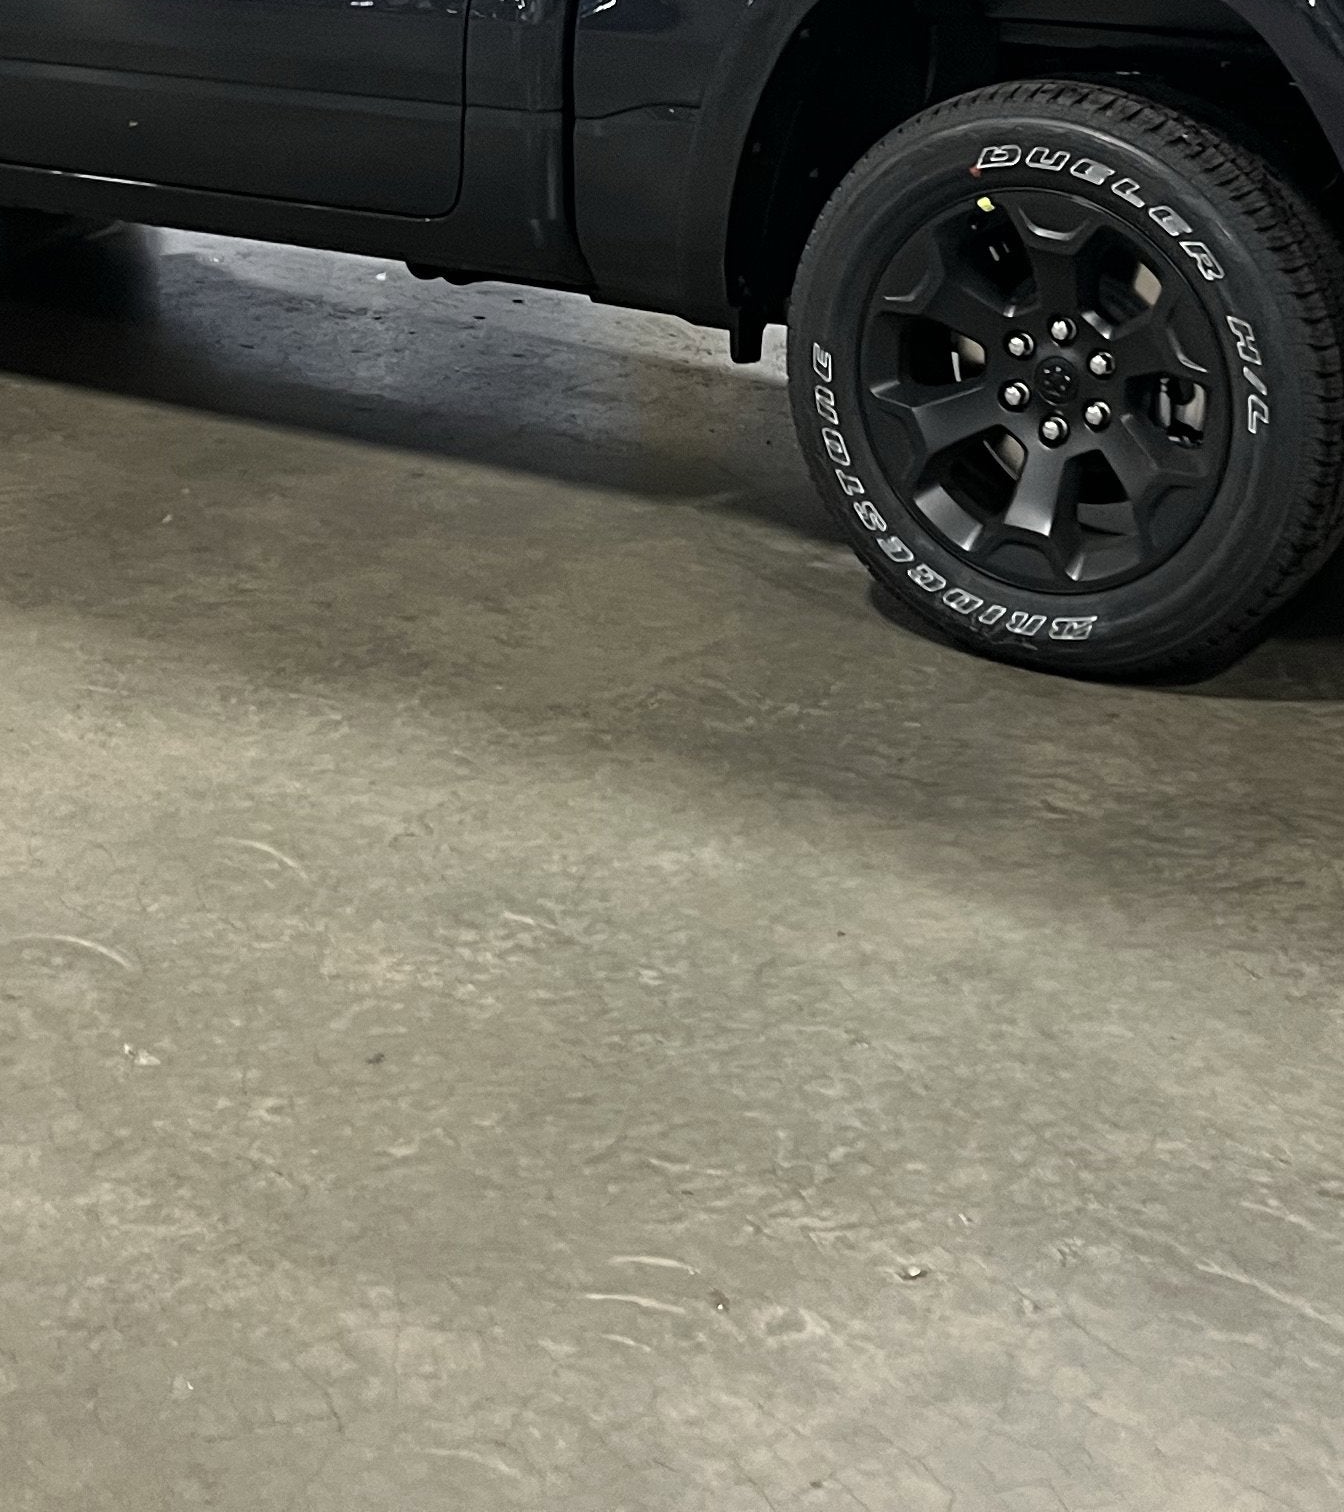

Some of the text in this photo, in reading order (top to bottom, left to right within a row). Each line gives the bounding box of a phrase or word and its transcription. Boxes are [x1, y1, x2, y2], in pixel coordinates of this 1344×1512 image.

[975, 144, 1226, 282] DUELER
[1224, 315, 1270, 435] H/L
[812, 342, 1098, 641] BRIDGESTONE
